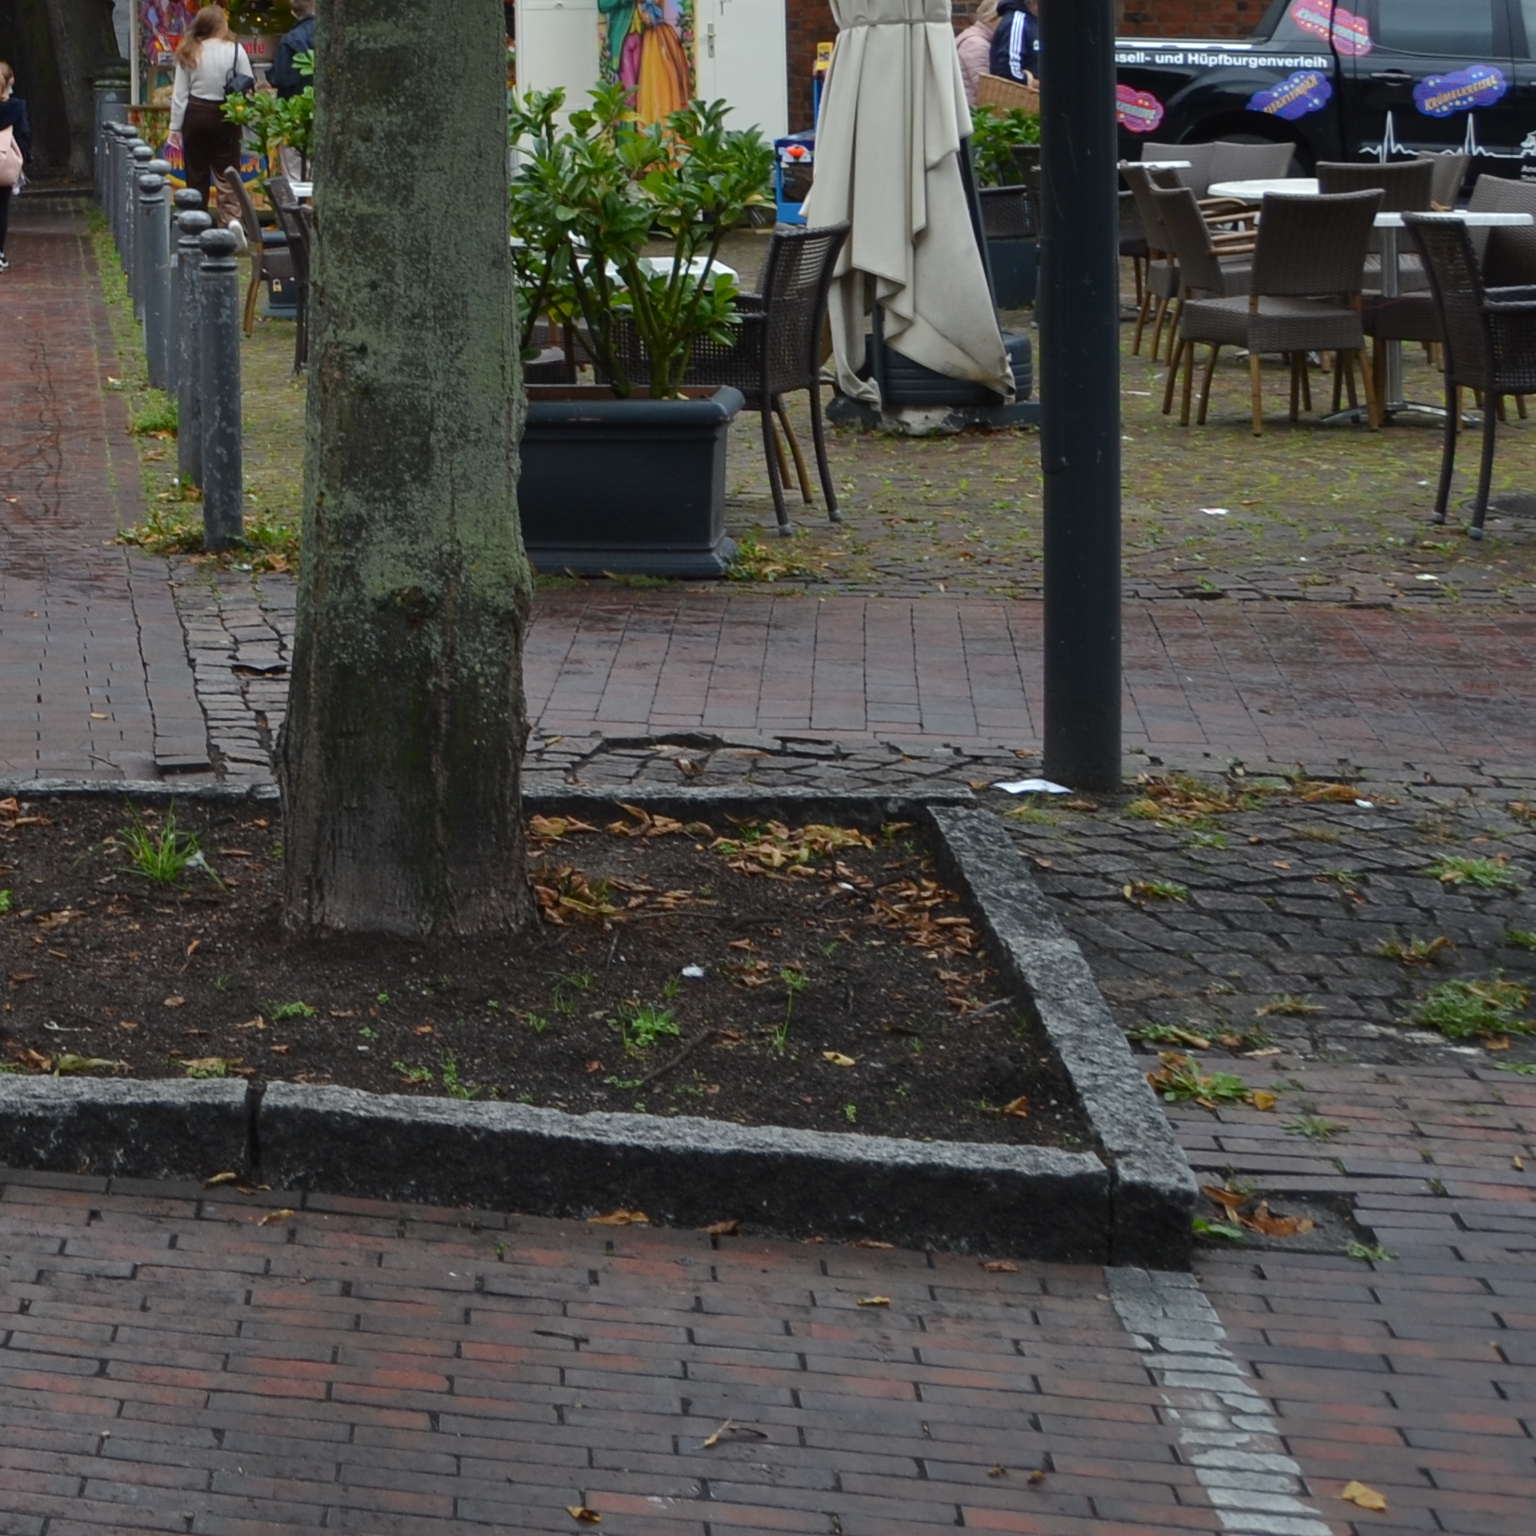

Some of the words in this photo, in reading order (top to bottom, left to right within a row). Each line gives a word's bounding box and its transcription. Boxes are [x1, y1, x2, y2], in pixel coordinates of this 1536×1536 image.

[1155, 52, 1184, 64] und
[1187, 52, 1328, 69] Hüpfburgenverleih
[1424, 73, 1498, 112] KRÜMELKREISEL
